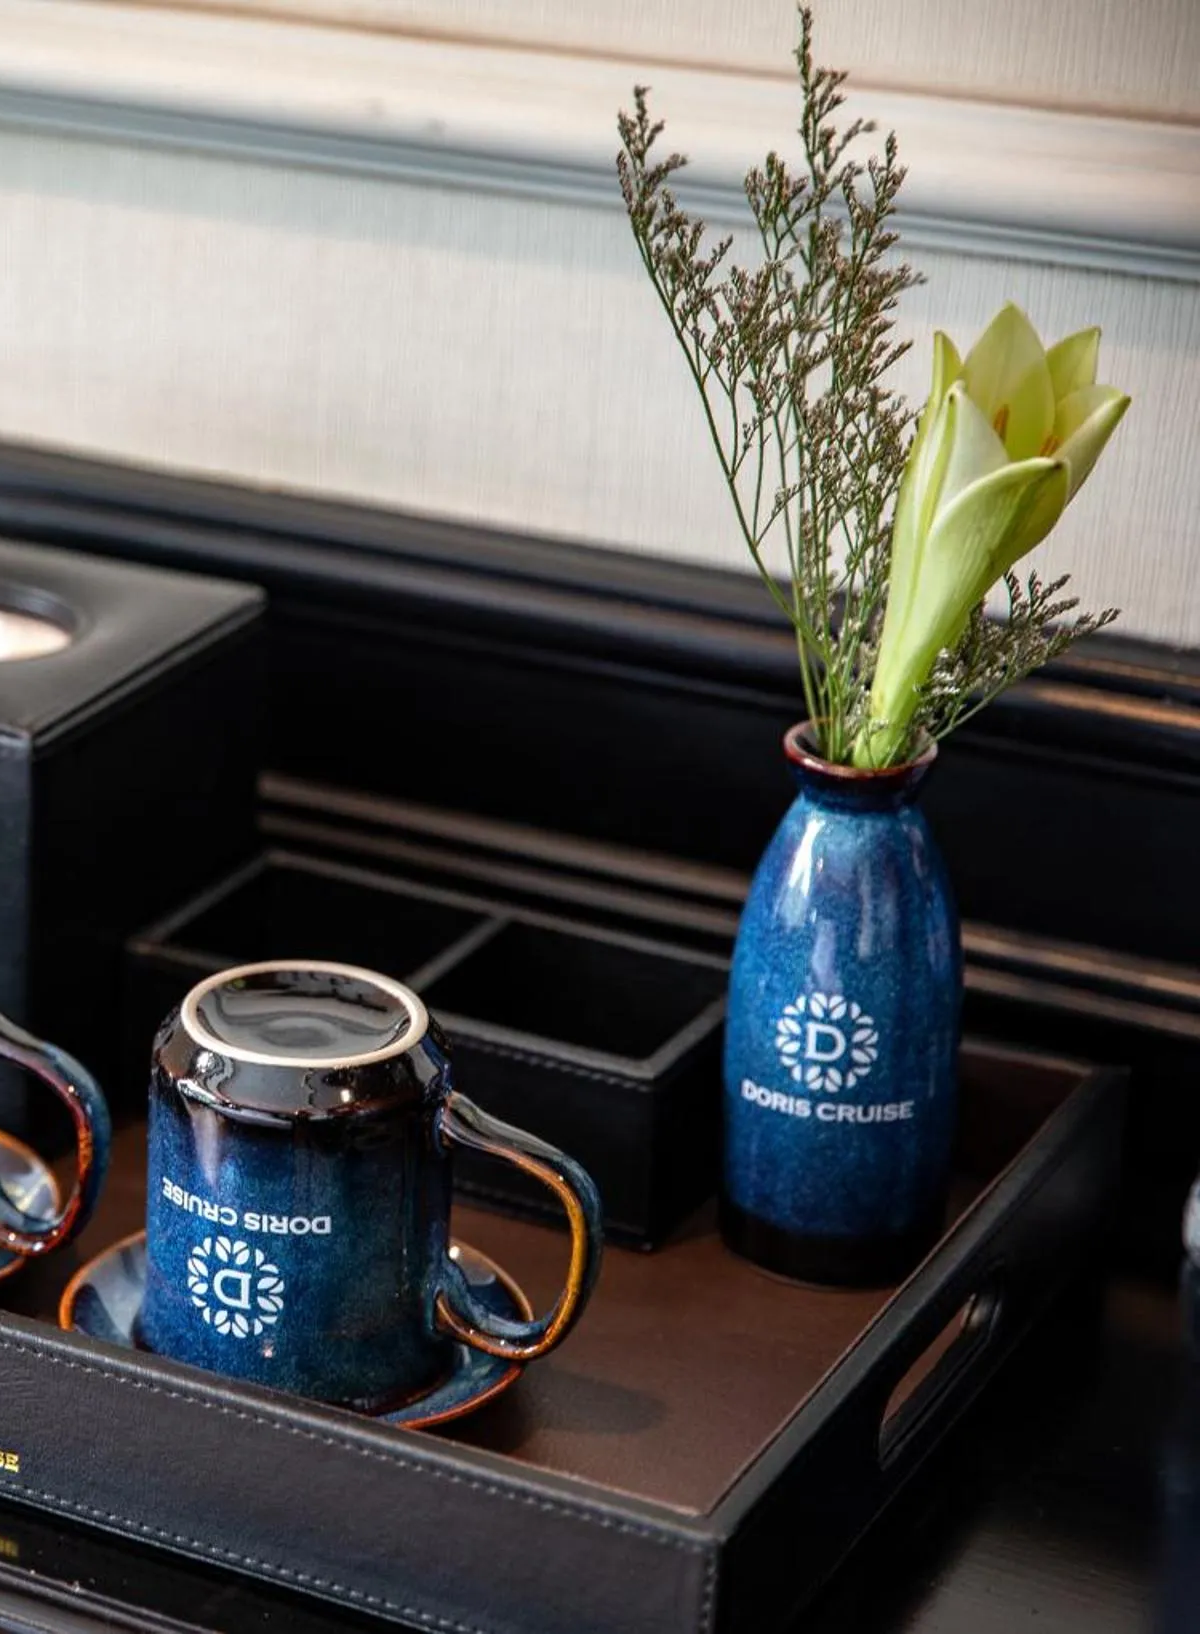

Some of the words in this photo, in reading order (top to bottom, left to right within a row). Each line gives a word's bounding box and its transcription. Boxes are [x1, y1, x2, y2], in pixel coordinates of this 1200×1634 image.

[804, 1021, 846, 1062] D
[741, 1079, 812, 1118] DORIS
[816, 1100, 915, 1123] CRUISE
[162, 1177, 237, 1226] CRUISE
[244, 1212, 332, 1235] DORIS
[213, 1268, 252, 1309] D
